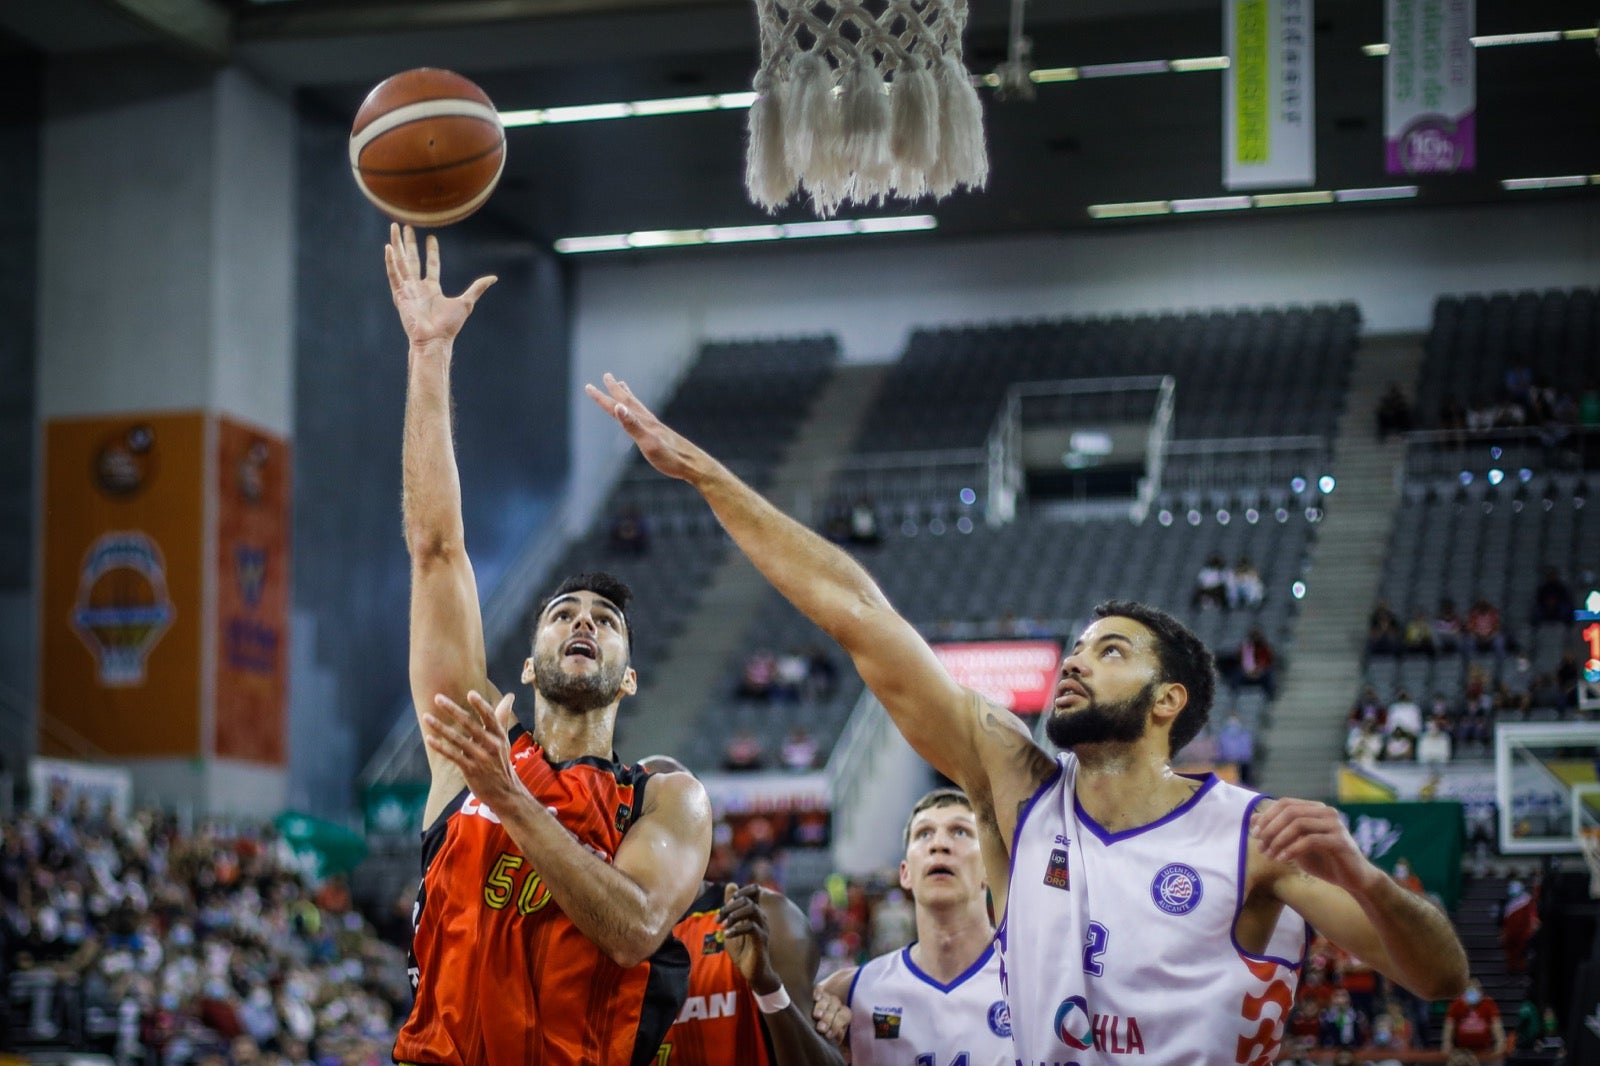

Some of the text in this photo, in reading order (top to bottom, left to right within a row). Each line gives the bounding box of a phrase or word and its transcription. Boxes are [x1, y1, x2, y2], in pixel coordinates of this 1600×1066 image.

[1051, 853, 1066, 865] Liga
[1160, 866, 1197, 883] LUCENTUM
[1046, 876, 1066, 888] ORO
[1158, 900, 1191, 913] ALICANTE
[1092, 1014, 1145, 1055] HLA
